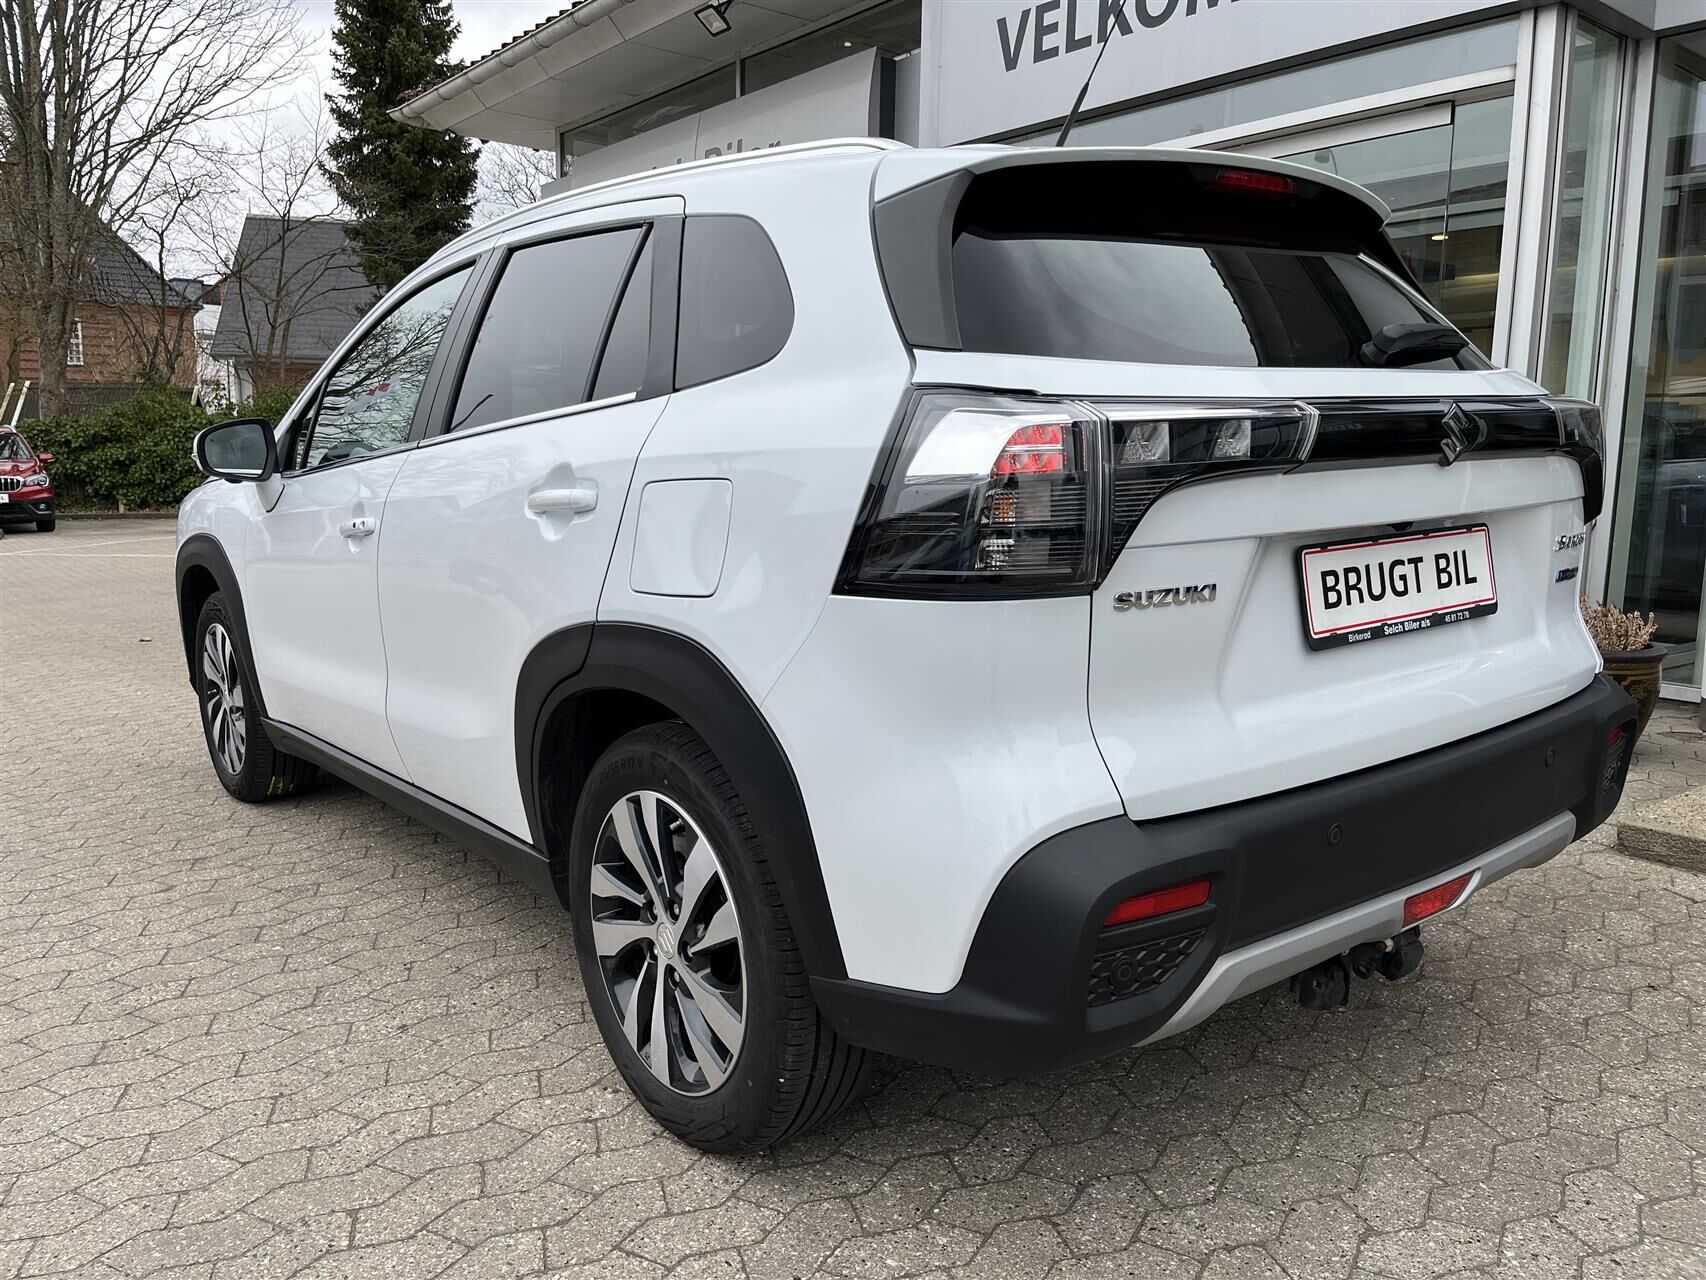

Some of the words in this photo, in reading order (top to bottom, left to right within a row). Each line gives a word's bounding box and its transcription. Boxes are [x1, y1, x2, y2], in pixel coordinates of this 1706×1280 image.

[996, 0, 1240, 72] VELKO
[1113, 583, 1217, 613] SUZUKI
[1320, 556, 1424, 610] BRUGT
[1434, 549, 1478, 590] BIL
[1383, 622, 1404, 636] Selch
[1404, 620, 1420, 631] Biler
